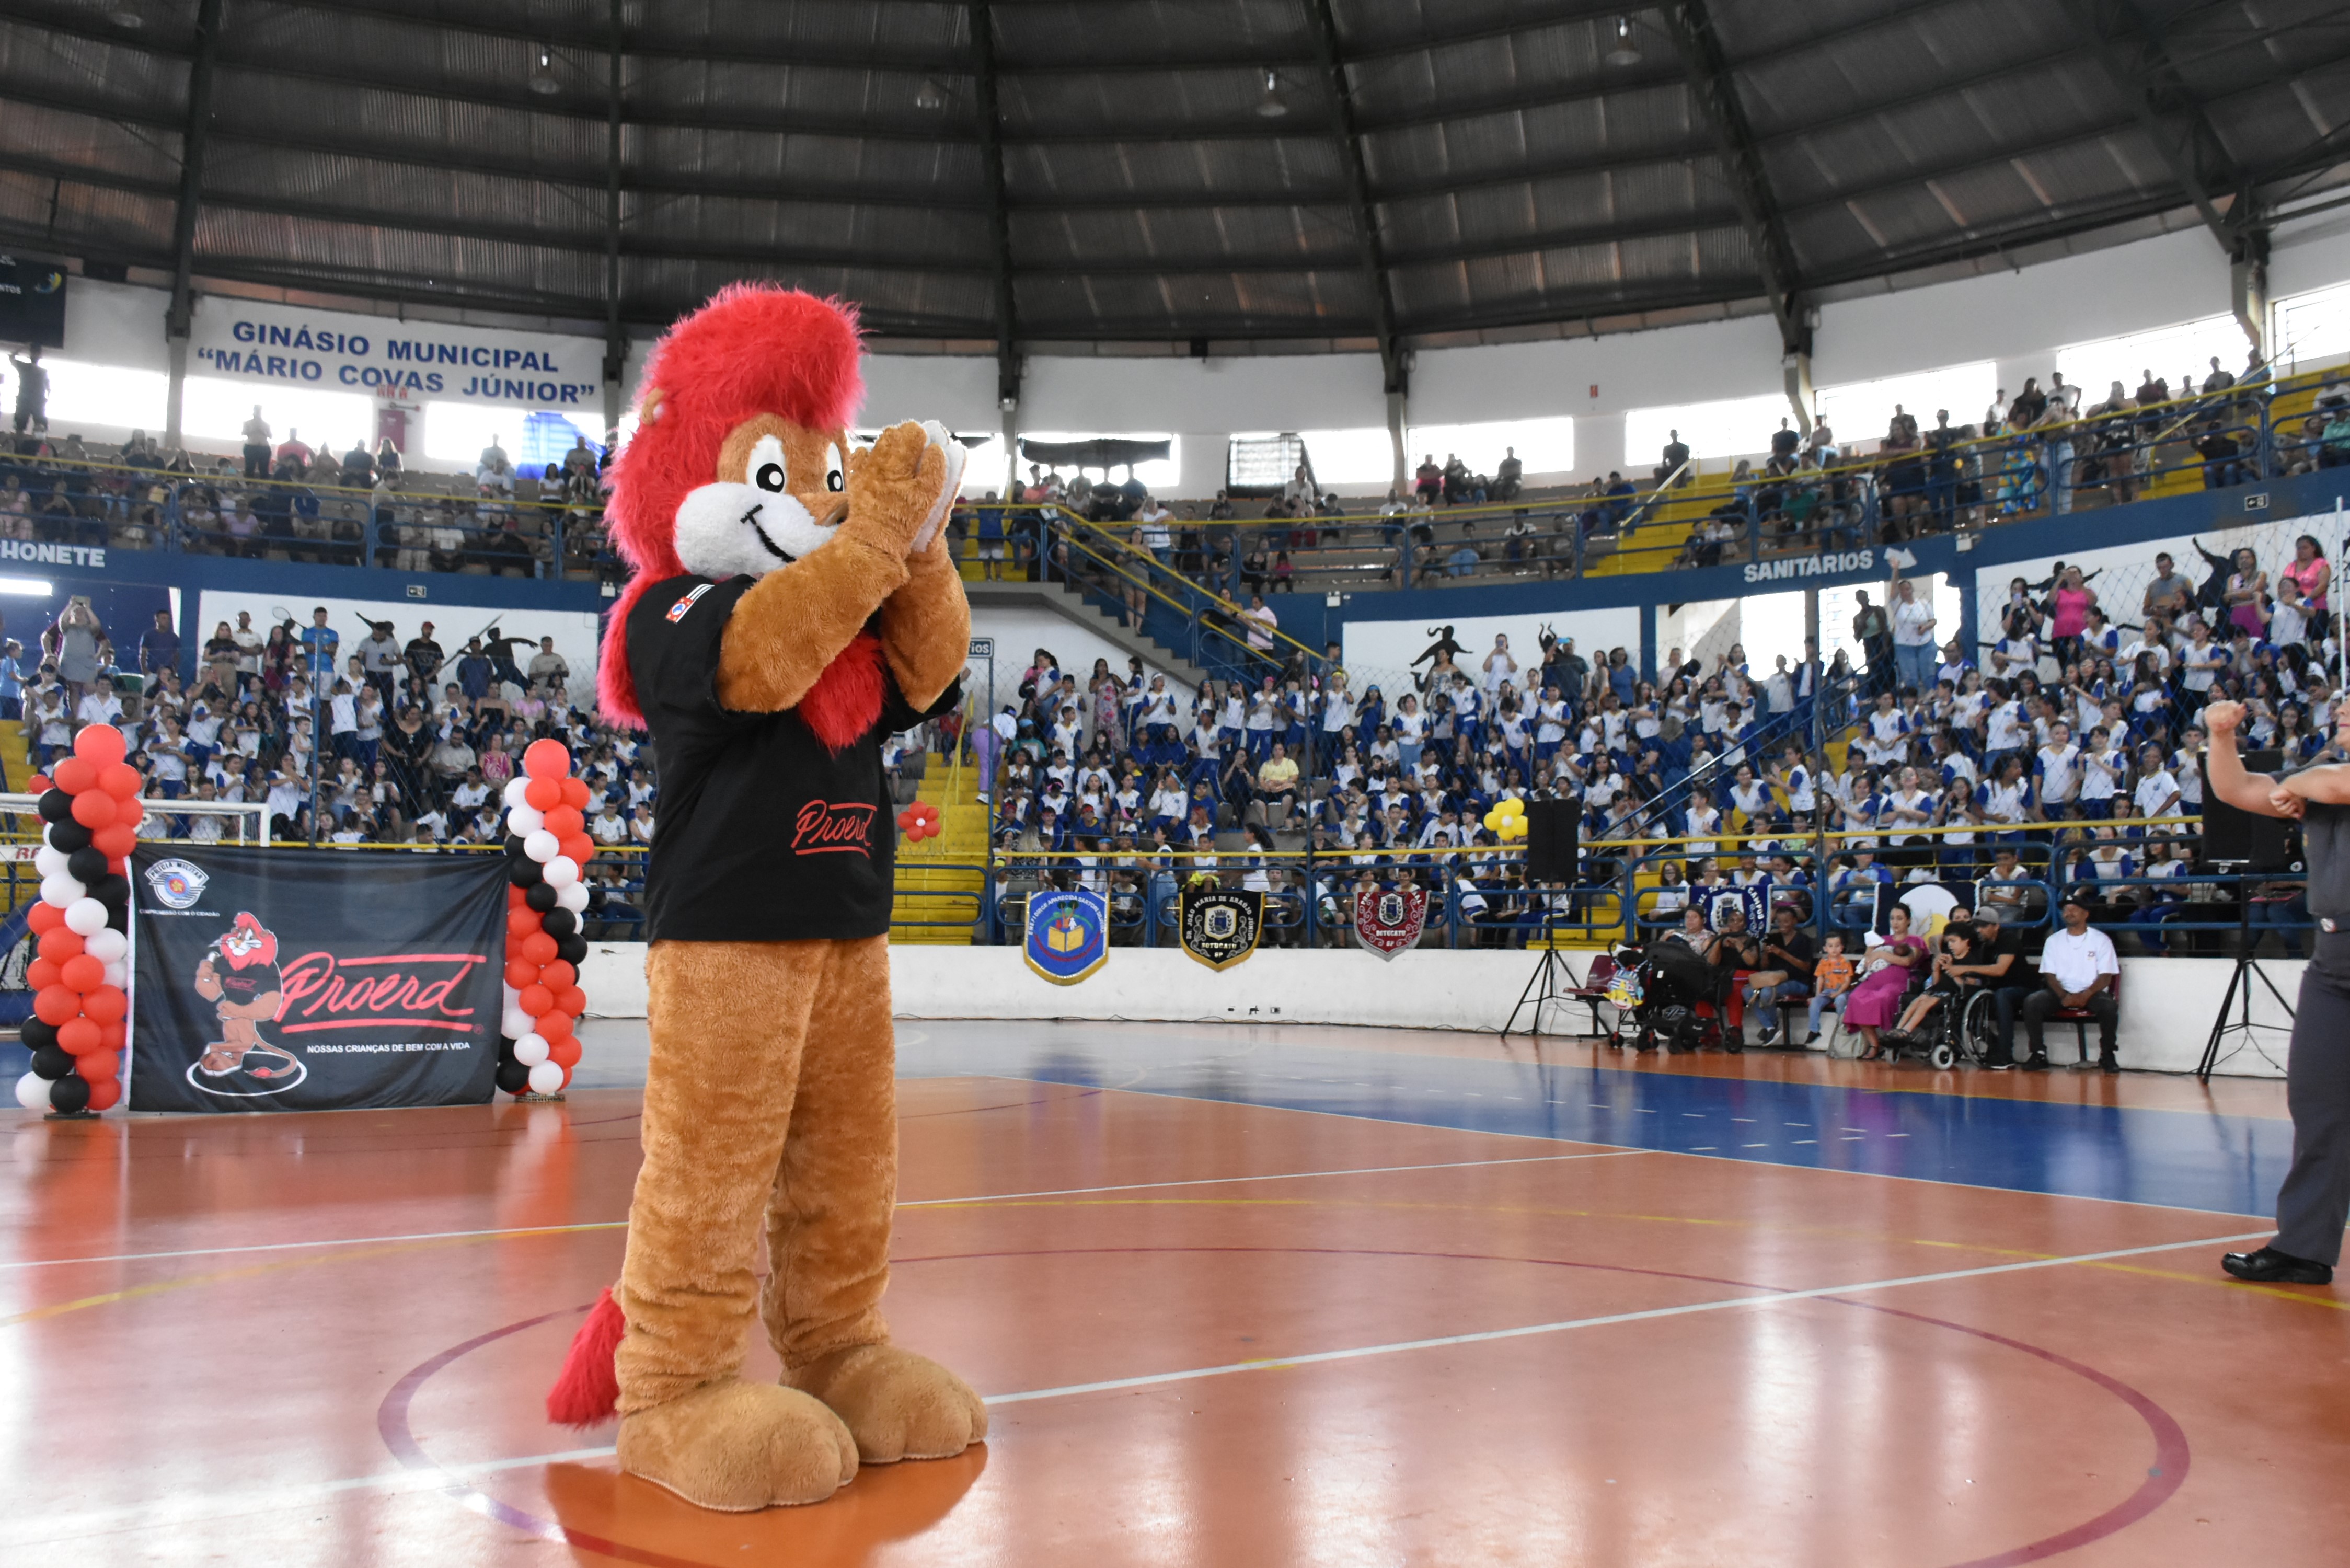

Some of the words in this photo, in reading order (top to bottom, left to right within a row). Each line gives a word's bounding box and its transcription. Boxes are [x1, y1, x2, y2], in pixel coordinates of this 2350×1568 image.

[233, 321, 370, 356] GINÁSIO
[387, 340, 559, 373] MUNICIPAL
[338, 365, 444, 393] COVAS
[0, 539, 105, 568] HONETE
[1744, 550, 1873, 582] SANITÁRIOS
[971, 642, 989, 653] ios
[1194, 895, 1216, 908] MARIA
[273, 951, 487, 1023] Proerd
[307, 1044, 343, 1053] NOSSAS
[345, 1044, 389, 1054] CRIANÇAS
